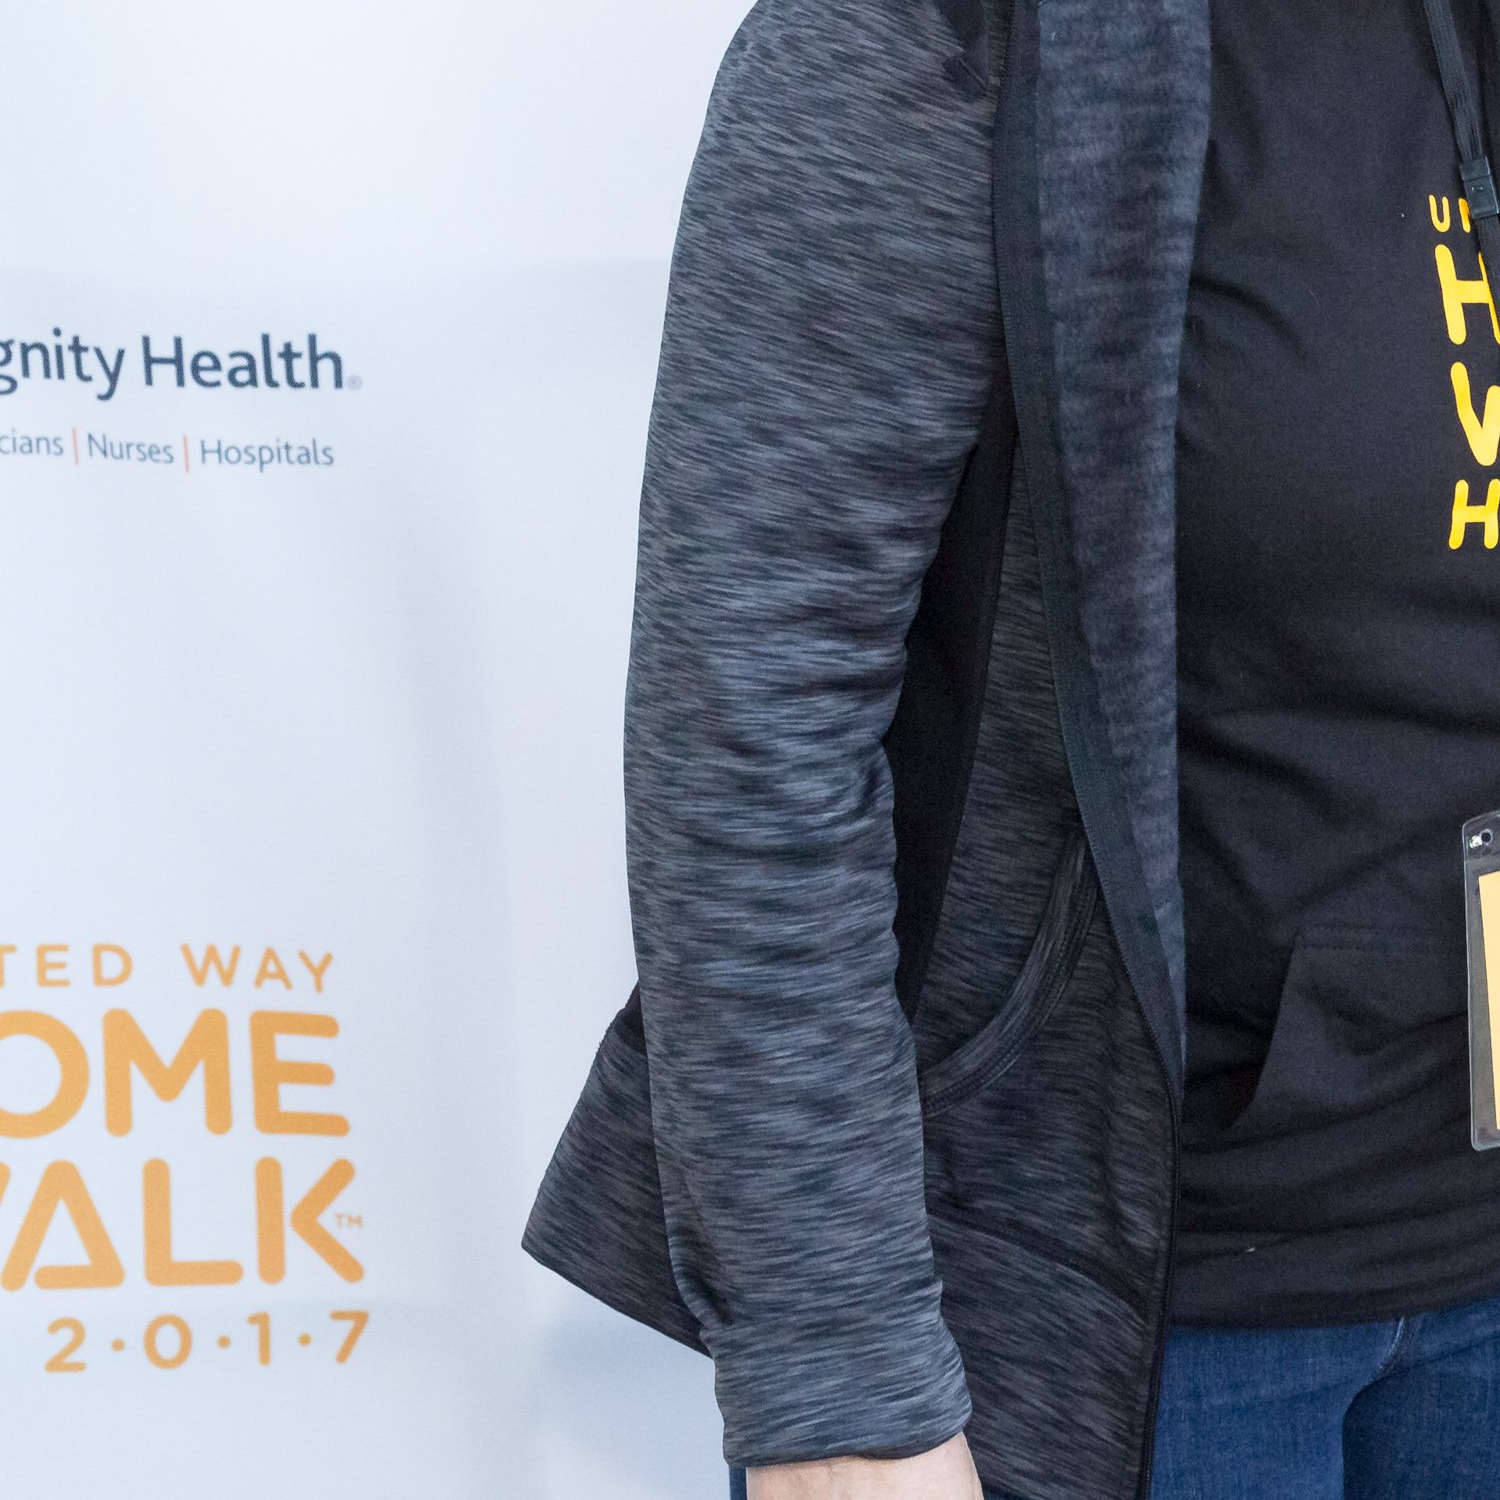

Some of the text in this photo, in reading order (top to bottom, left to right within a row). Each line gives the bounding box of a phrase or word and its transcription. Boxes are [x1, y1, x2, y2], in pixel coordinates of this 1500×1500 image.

[141, 332, 345, 390] Health
[86, 431, 175, 465] Nurses
[199, 437, 335, 473] Hospitals
[179, 941, 335, 994] WAY
[0, 1155, 365, 1292] ALK
